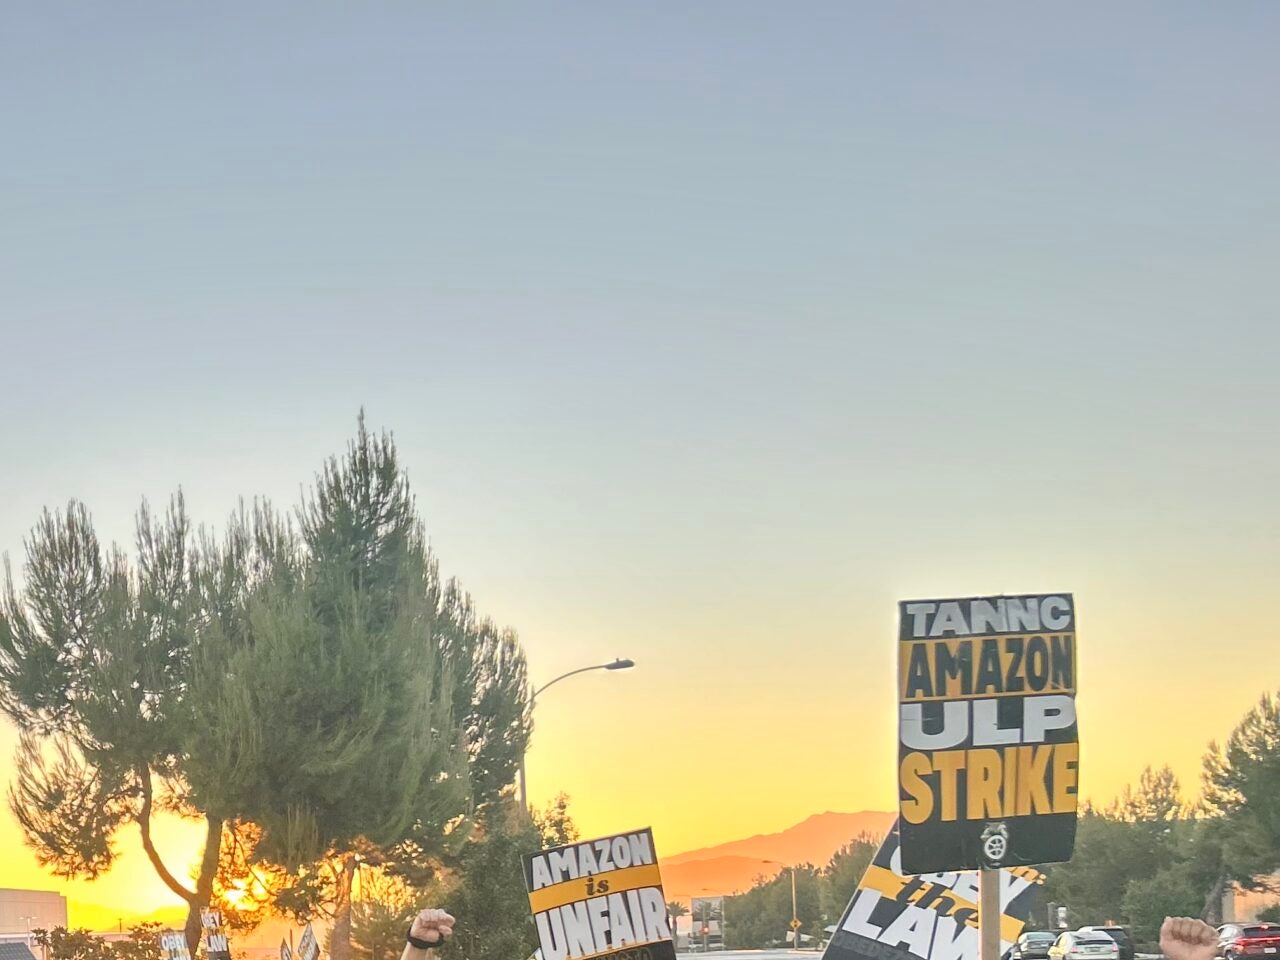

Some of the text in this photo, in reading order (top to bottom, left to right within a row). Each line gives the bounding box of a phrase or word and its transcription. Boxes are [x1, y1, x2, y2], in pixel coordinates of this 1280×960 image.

[906, 596, 1070, 637] TANNC
[905, 635, 1074, 698] AMAZON
[900, 695, 1076, 750] ULP
[900, 743, 1078, 824] STRIKE
[532, 833, 653, 891] AMAZON
[585, 878, 609, 895] is
